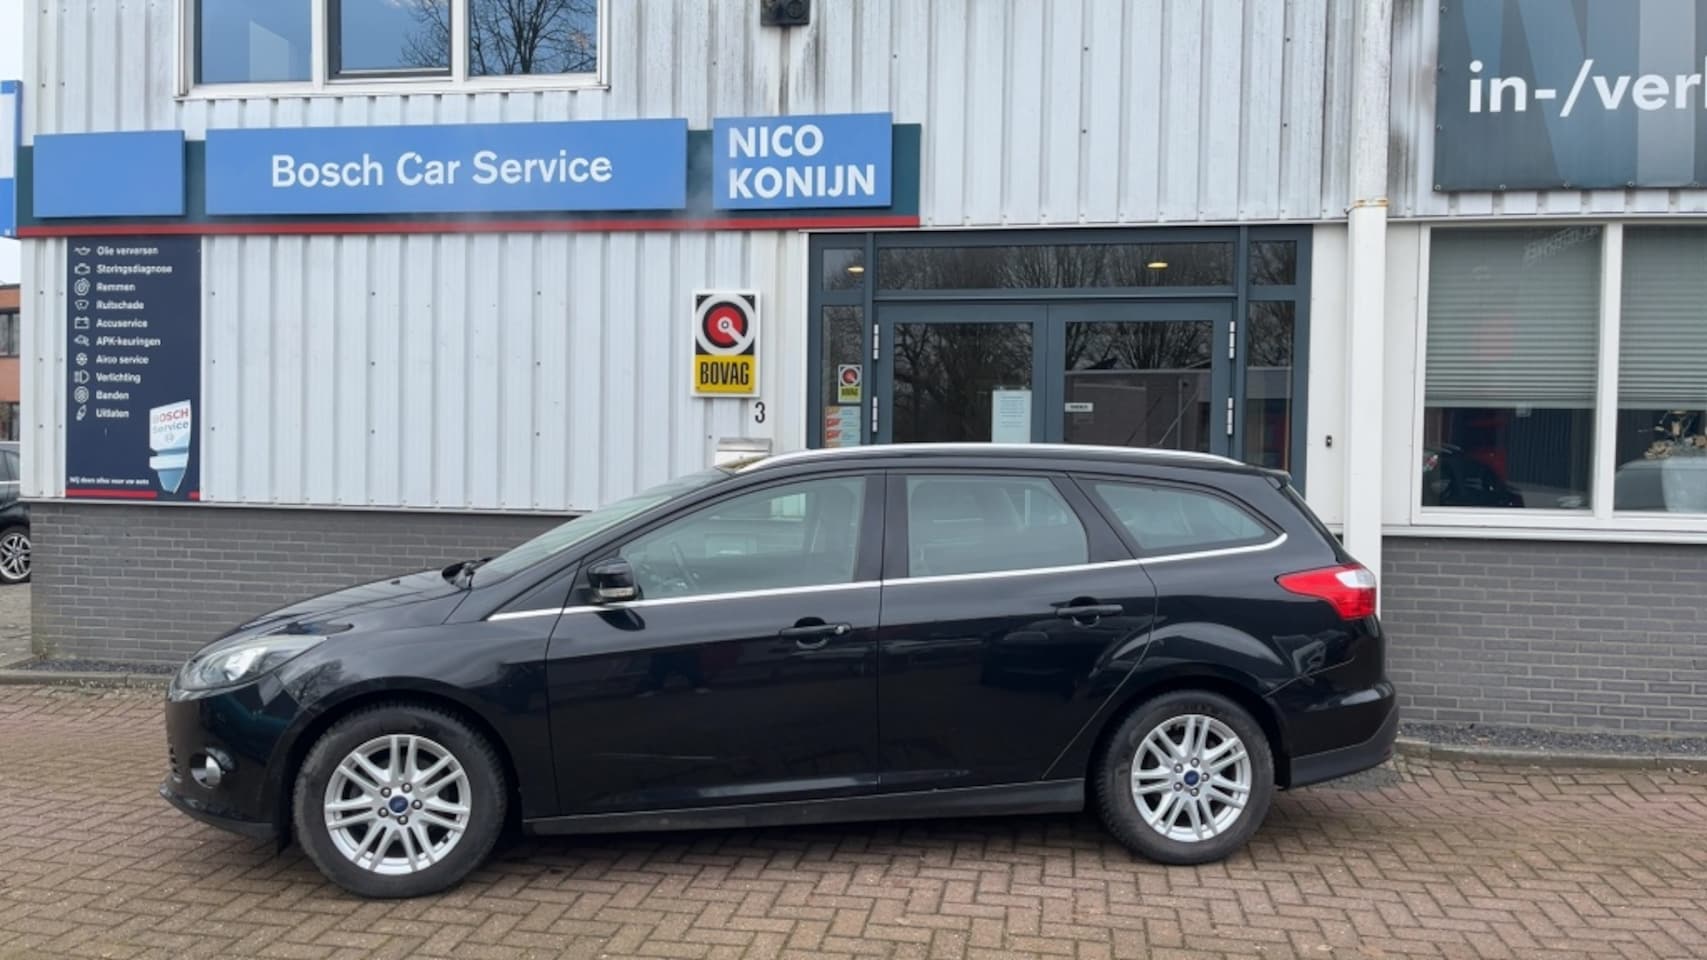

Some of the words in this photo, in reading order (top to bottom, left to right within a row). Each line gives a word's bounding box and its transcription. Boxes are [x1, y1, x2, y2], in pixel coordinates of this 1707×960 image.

[1469, 59, 1707, 117] in-/ver
[728, 124, 824, 158] NICO
[271, 153, 384, 188] Bosch
[397, 151, 461, 186] Car
[472, 149, 613, 185] Service
[728, 164, 875, 199] KONIJN
[96, 246, 114, 256] Olie
[116, 247, 159, 256] verversen
[96, 264, 173, 275] Storingsdiagnose
[96, 282, 136, 292] Remmen
[96, 300, 145, 310] Ruitschade
[96, 317, 148, 328] Accuservice
[96, 336, 161, 348] APK-keuringen
[96, 354, 118, 364] Airco
[119, 355, 150, 365] service
[95, 372, 142, 384] Verlichting
[700, 361, 749, 386] BOVAG
[95, 390, 129, 400] Banden
[95, 407, 129, 418] Uitlaten
[755, 401, 766, 423] 3
